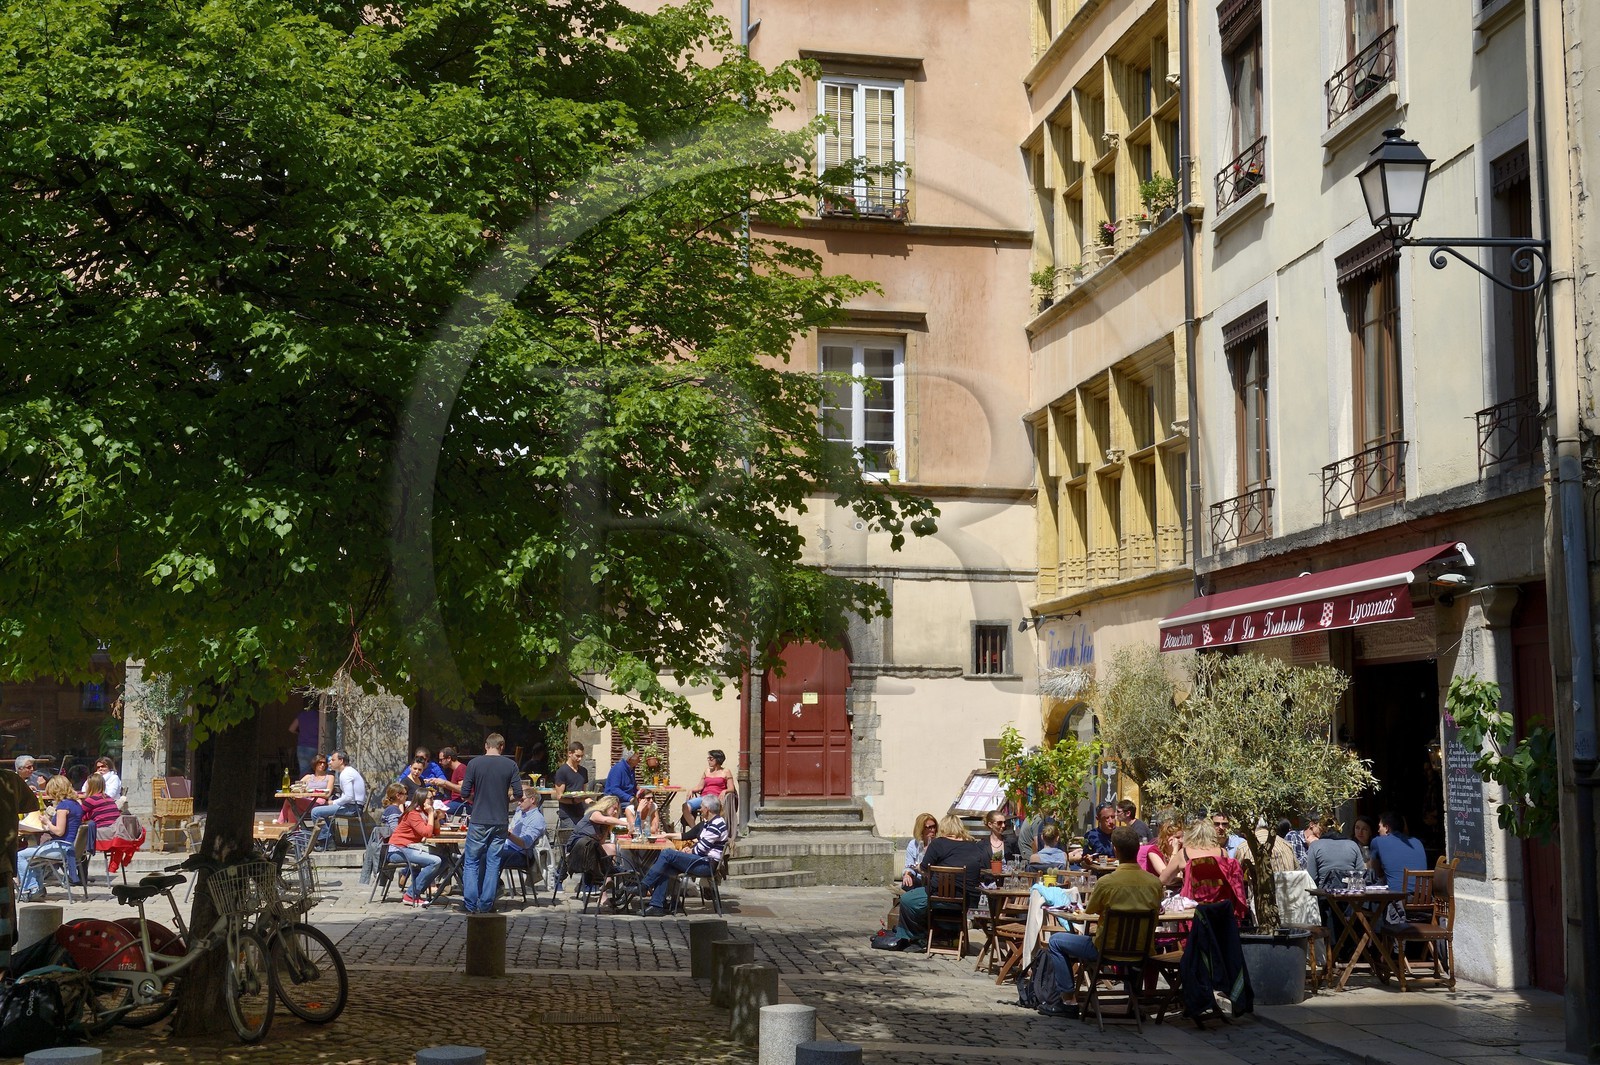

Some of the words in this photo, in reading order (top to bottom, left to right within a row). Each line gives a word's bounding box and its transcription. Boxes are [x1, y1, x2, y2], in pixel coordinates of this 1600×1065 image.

[1162, 629, 1193, 649] Bouchon
[1224, 619, 1236, 643] A
[1241, 615, 1255, 640] La
[1263, 607, 1305, 637] Traboule
[1349, 592, 1397, 624] Lyonnais
[118, 962, 137, 971] 11764
